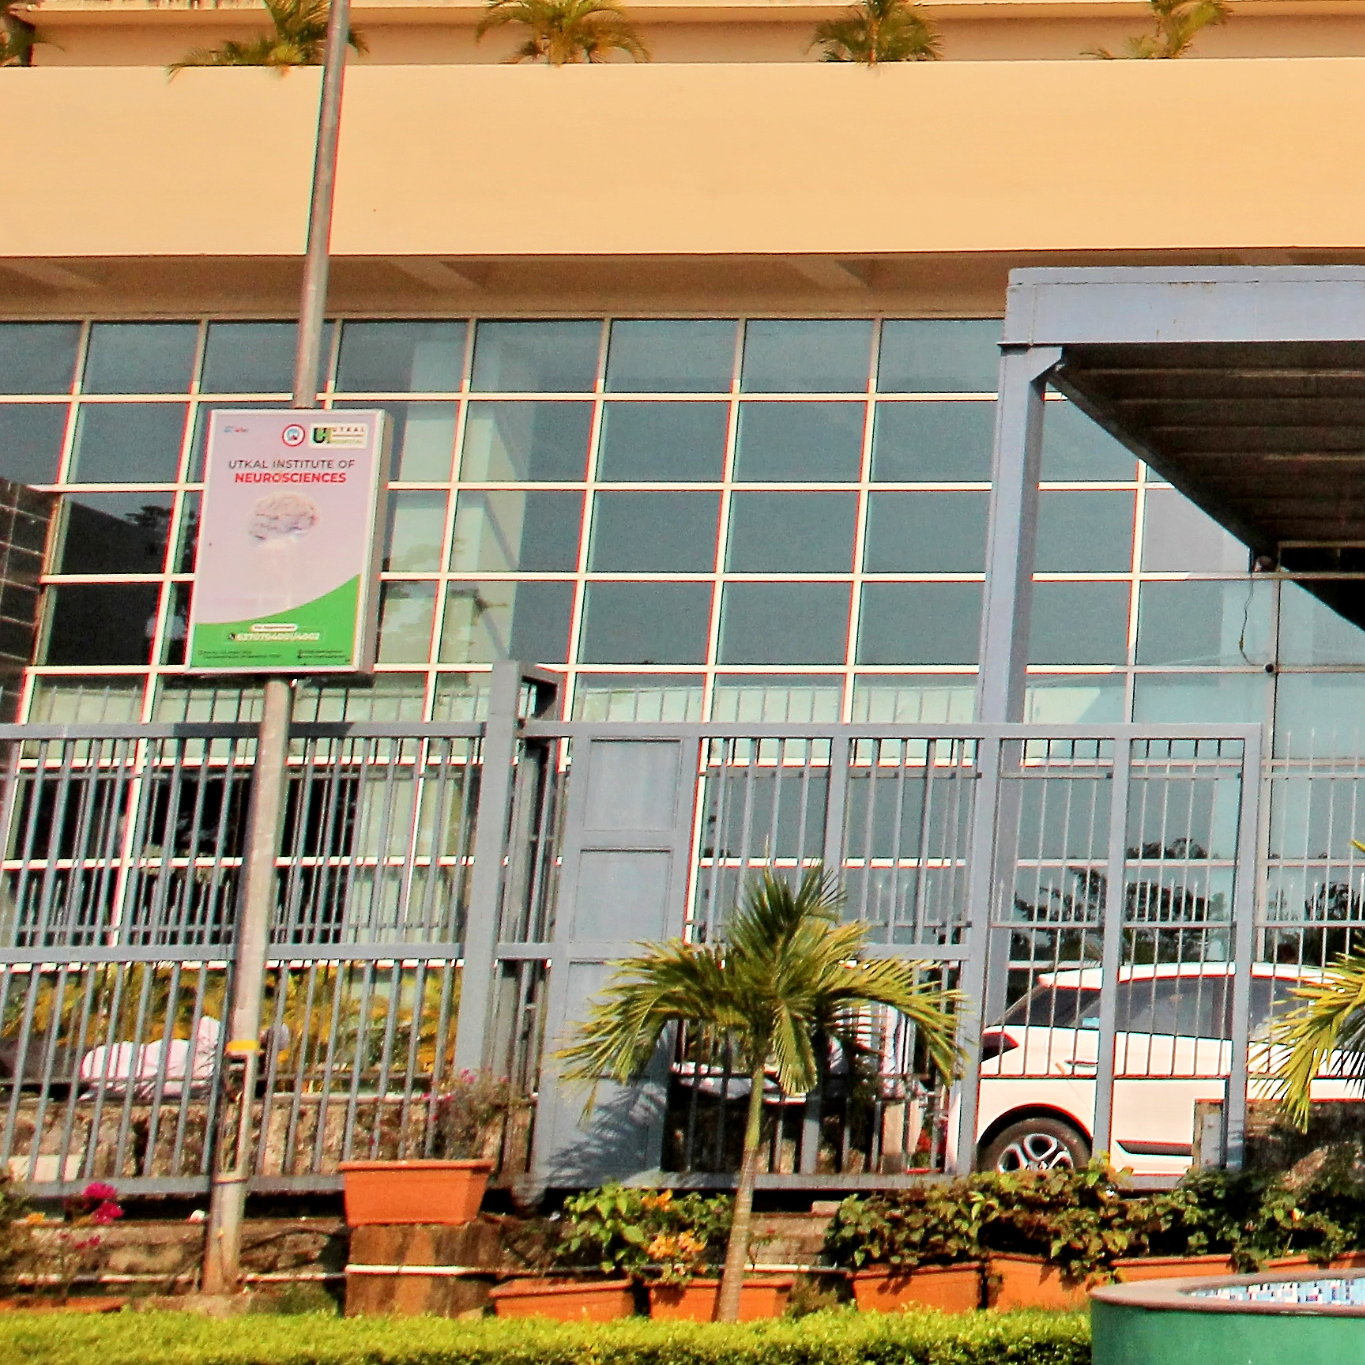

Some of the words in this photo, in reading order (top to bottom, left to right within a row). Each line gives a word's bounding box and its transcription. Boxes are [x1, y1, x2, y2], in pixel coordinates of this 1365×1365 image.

[228, 459, 269, 470] UTKAL
[272, 459, 333, 469] INSTITUTE
[338, 459, 356, 469] OF
[234, 472, 347, 483] NEUROSCIENCES
